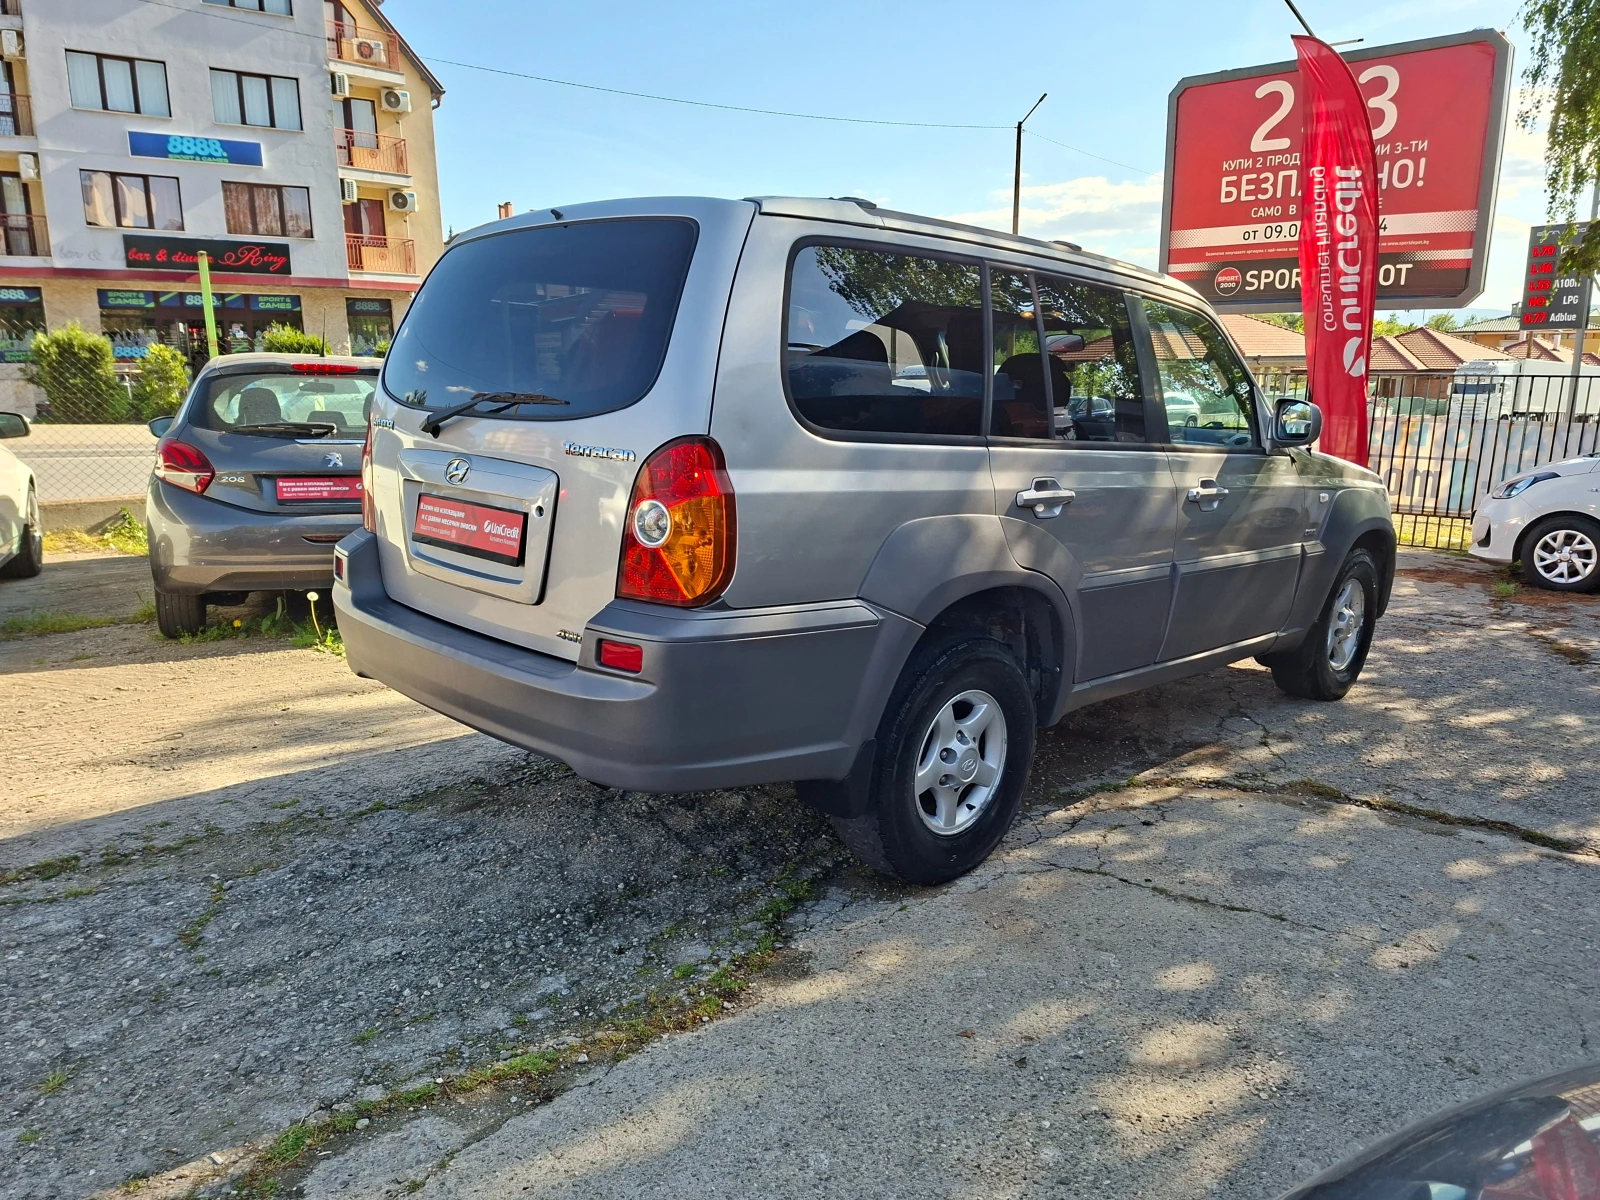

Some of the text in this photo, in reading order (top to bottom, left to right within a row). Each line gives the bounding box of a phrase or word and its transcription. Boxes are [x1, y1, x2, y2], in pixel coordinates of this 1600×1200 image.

[1359, 65, 1399, 140] 3
[1250, 80, 1294, 152] 2
[1222, 152, 1301, 171] КУПИ 2 ПРОД
[1377, 157, 1426, 190] НО!
[1220, 169, 1302, 203] БЕЗП
[1251, 204, 1297, 218] САМО В
[1264, 223, 1298, 239] 09.0
[127, 247, 151, 261] bar
[156, 248, 168, 262] &
[218, 245, 287, 272] Ring
[1245, 268, 1302, 291] SPOR
[1378, 263, 1413, 286] OT
[108, 297, 146, 305] GAMES
[1562, 295, 1579, 305] LPG
[1523, 312, 1577, 324] 0.77 Adblue
[563, 440, 636, 462] Terracan
[491, 522, 519, 539] UniCredit
